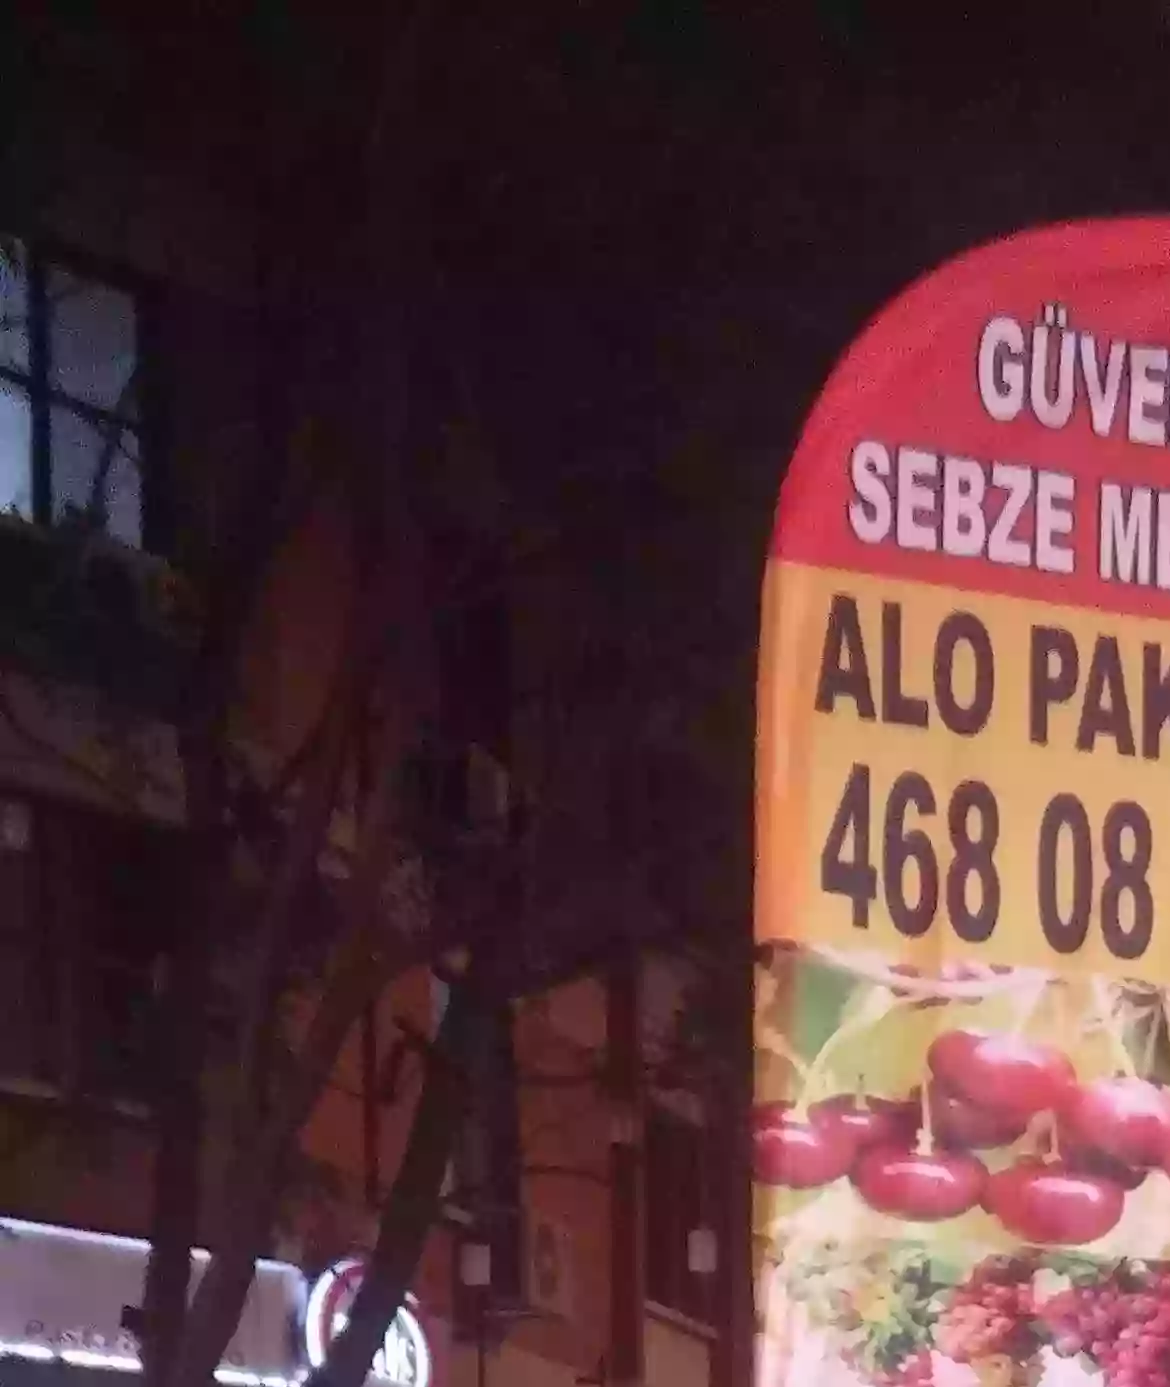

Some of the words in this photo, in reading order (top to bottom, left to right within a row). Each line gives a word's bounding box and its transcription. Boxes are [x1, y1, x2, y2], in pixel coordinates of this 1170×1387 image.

[848, 441, 1076, 573] SEBZE
[815, 595, 994, 736] ALO
[821, 762, 1000, 943] 468
[1038, 792, 1152, 961] 08
